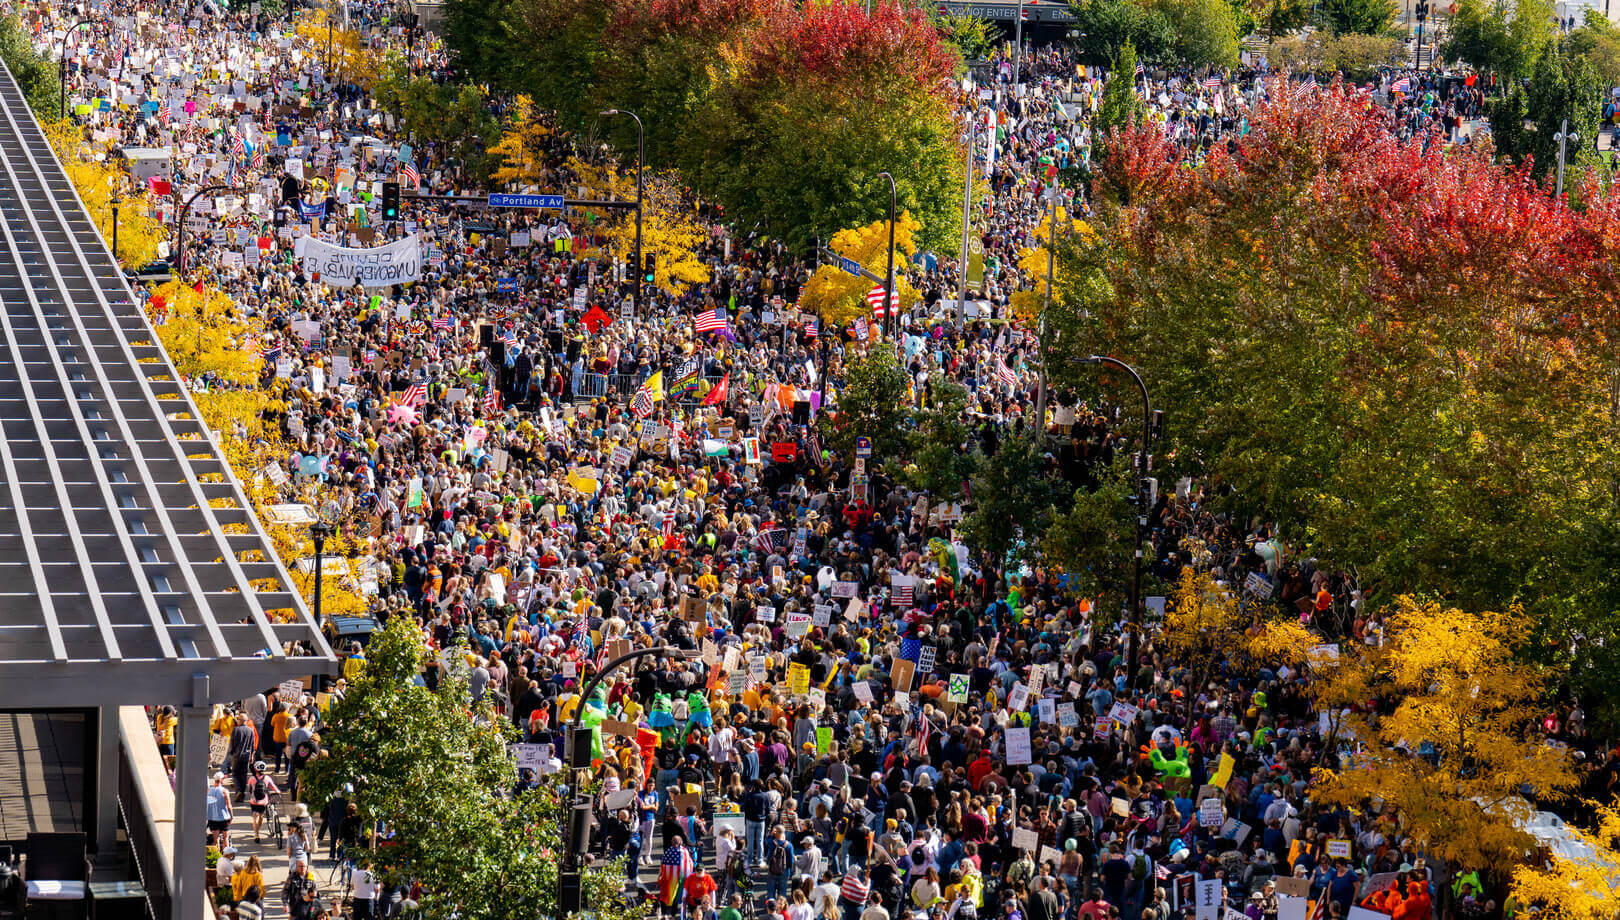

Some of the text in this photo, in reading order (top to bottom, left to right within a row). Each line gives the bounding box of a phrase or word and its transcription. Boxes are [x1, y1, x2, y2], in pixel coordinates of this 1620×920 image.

[967, 7, 984, 16] NOT
[987, 8, 1017, 17] ENTER
[502, 196, 562, 206] Portland Av
